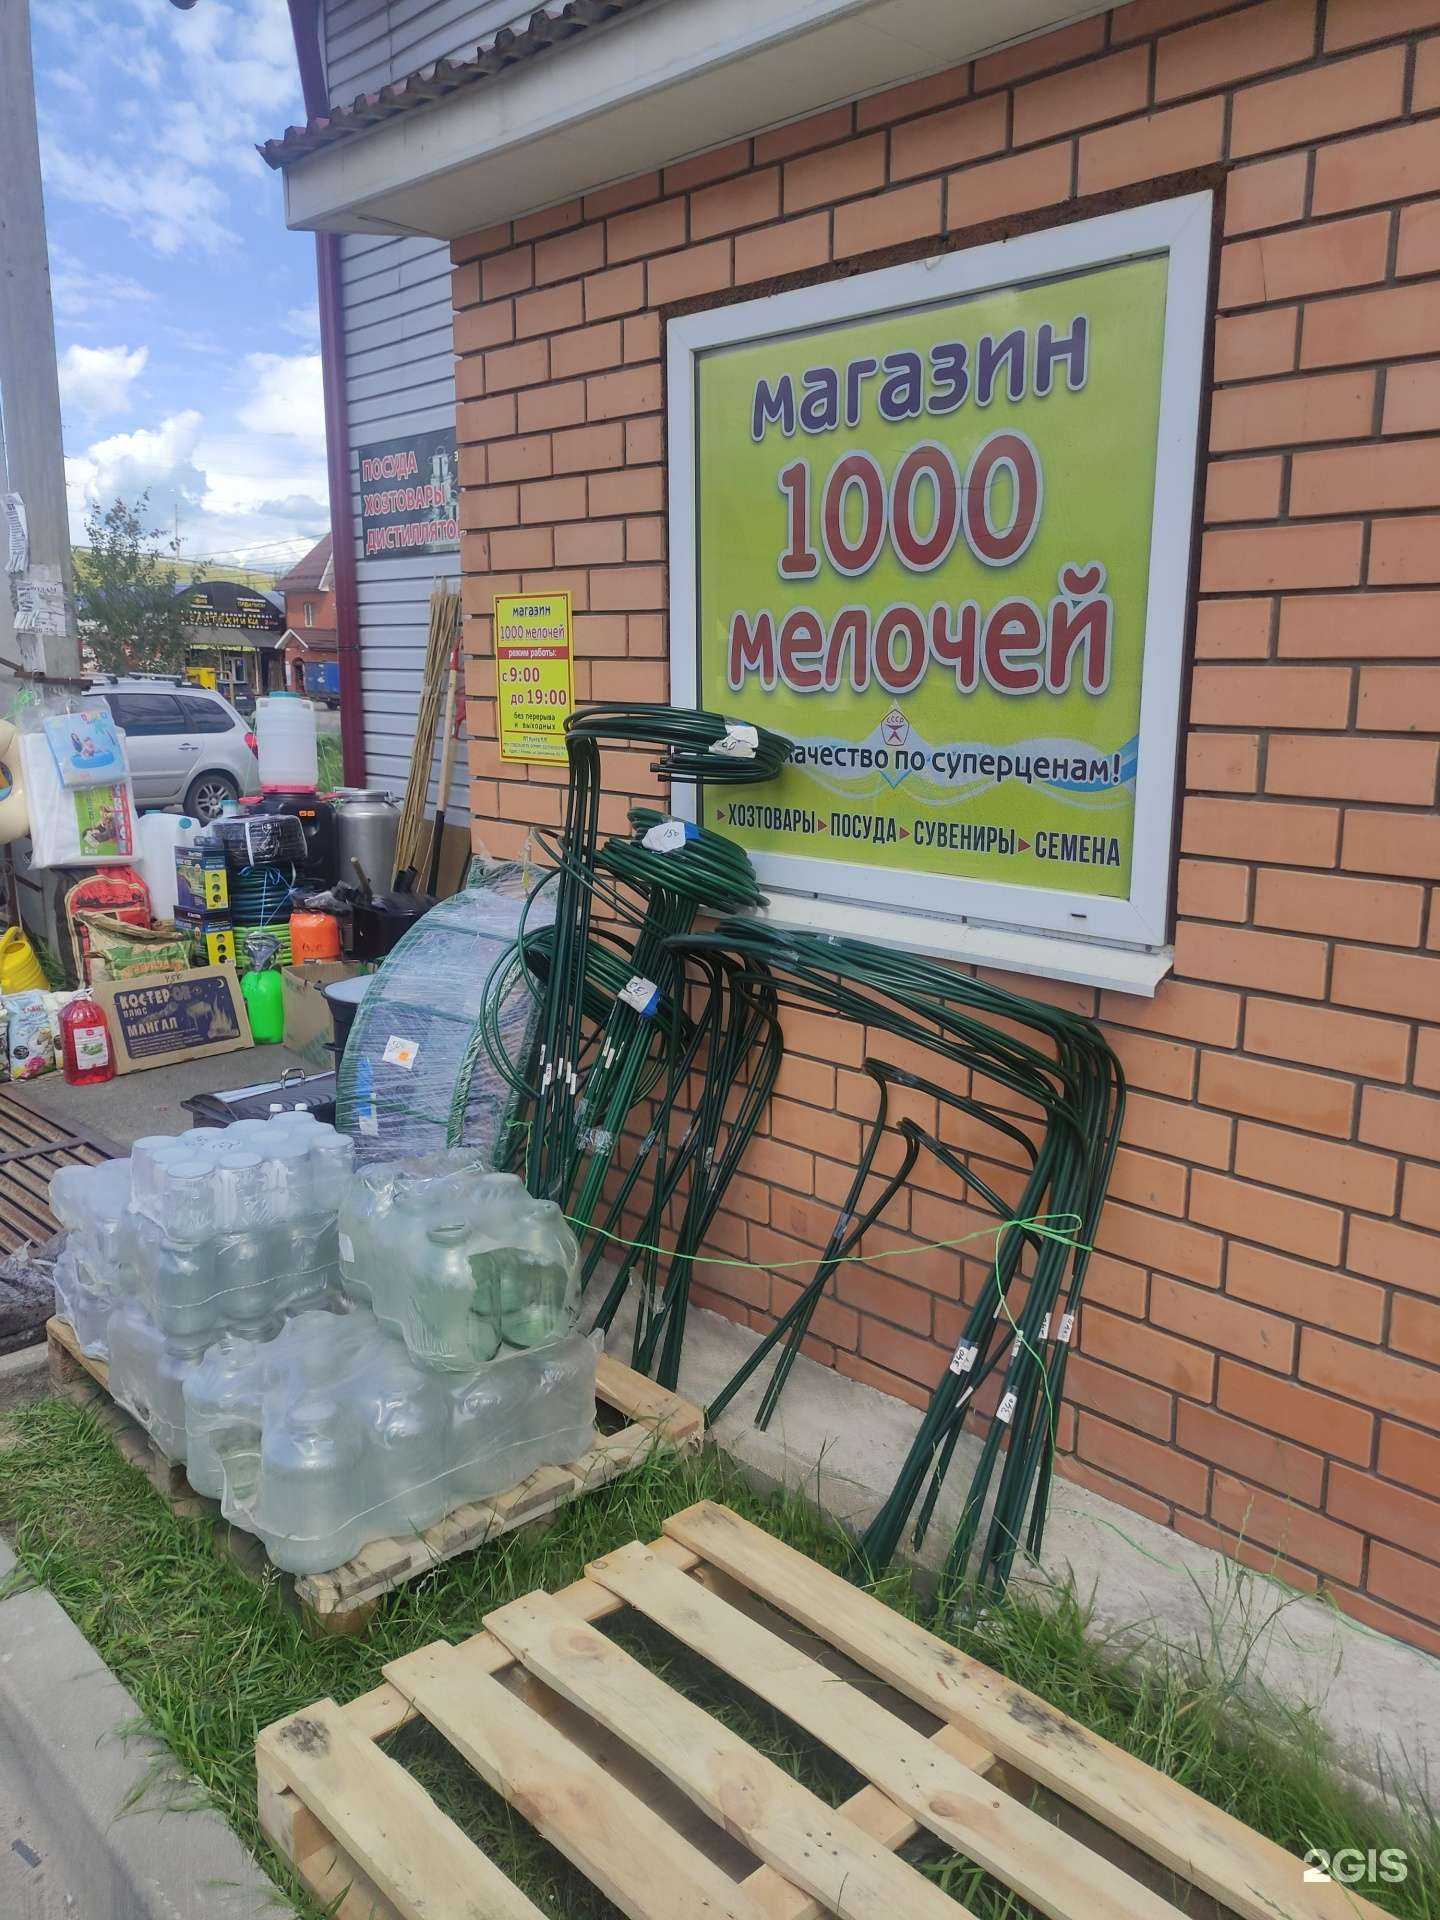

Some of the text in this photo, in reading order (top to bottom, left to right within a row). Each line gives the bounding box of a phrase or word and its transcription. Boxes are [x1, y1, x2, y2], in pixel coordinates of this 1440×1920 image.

[752, 315, 1087, 441] магазин
[362, 451, 418, 482] ПОСУДА
[364, 485, 447, 517] ХОЗТОВАРЫ
[779, 431, 1041, 577] 1000
[366, 519, 459, 555] ДИСТИЛЛЯТО
[512, 605, 551, 617] магазин
[501, 624, 565, 640] 1000 мелочей
[729, 563, 1111, 693] мелочей
[510, 667, 540, 682] 9:00
[511, 689, 567, 705] до 19:00
[895, 750, 926, 770] по
[931, 751, 1121, 784] суперценам!
[728, 803, 1121, 866] ХОЗТОВАРЫ ПОСУДА СУВЕНИРЫ СЕМЕНА
[127, 1017, 178, 1037] МАНГАЛ
